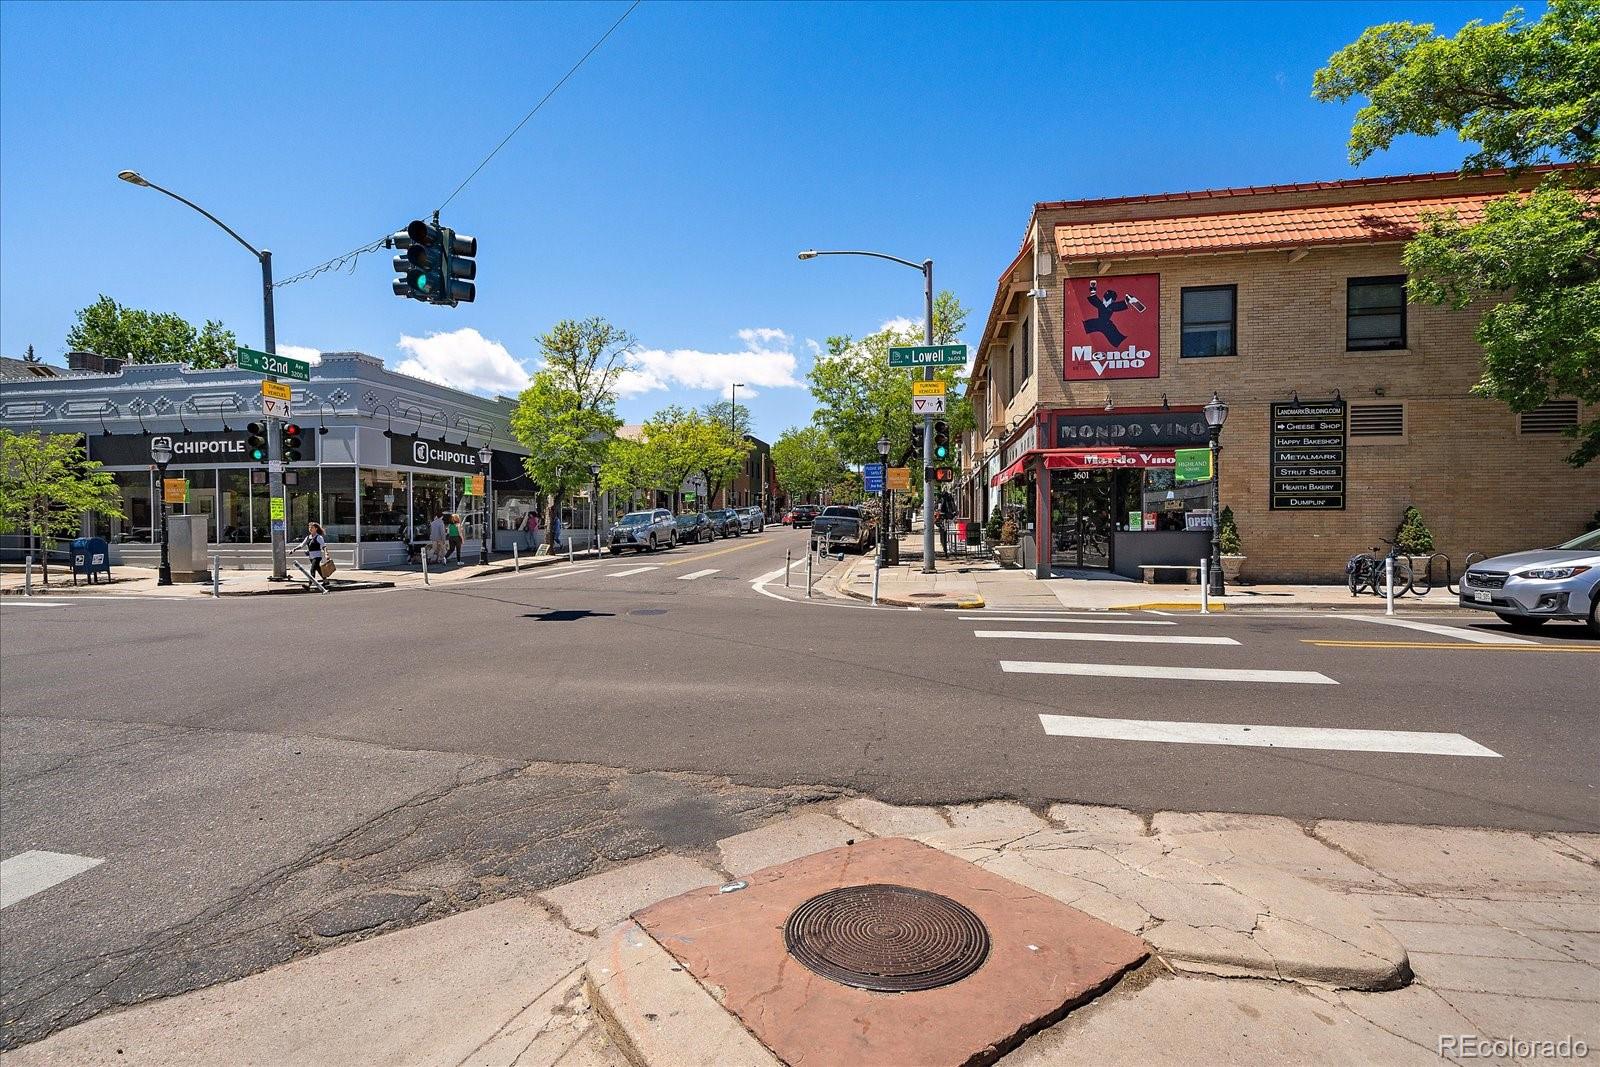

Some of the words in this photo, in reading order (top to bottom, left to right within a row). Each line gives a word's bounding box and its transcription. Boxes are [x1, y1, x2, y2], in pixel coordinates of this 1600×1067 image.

[911, 349, 944, 363] Lowell
[1071, 345, 1151, 361] Mondo
[261, 356, 288, 374] 32nd
[1090, 359, 1145, 376] Vino
[1061, 423, 1144, 438] MONDO
[1150, 422, 1206, 436] VINO
[1320, 422, 1341, 430] SHOP
[173, 440, 246, 454] CHIPOTLE
[1277, 438, 1300, 446] HAPPY
[1303, 437, 1340, 445] BAKESHOP
[429, 448, 476, 466] CHIPOTLE
[1084, 454, 1136, 465] Mondo
[1140, 453, 1176, 465] Vino
[1280, 453, 1337, 461] METALMARK
[1073, 471, 1089, 479] 3601
[1280, 468, 1306, 476] STRUT
[1308, 483, 1334, 491] BAKERY
[1290, 498, 1326, 506] DUMPLIN'
[1188, 516, 1212, 527] OPEN
